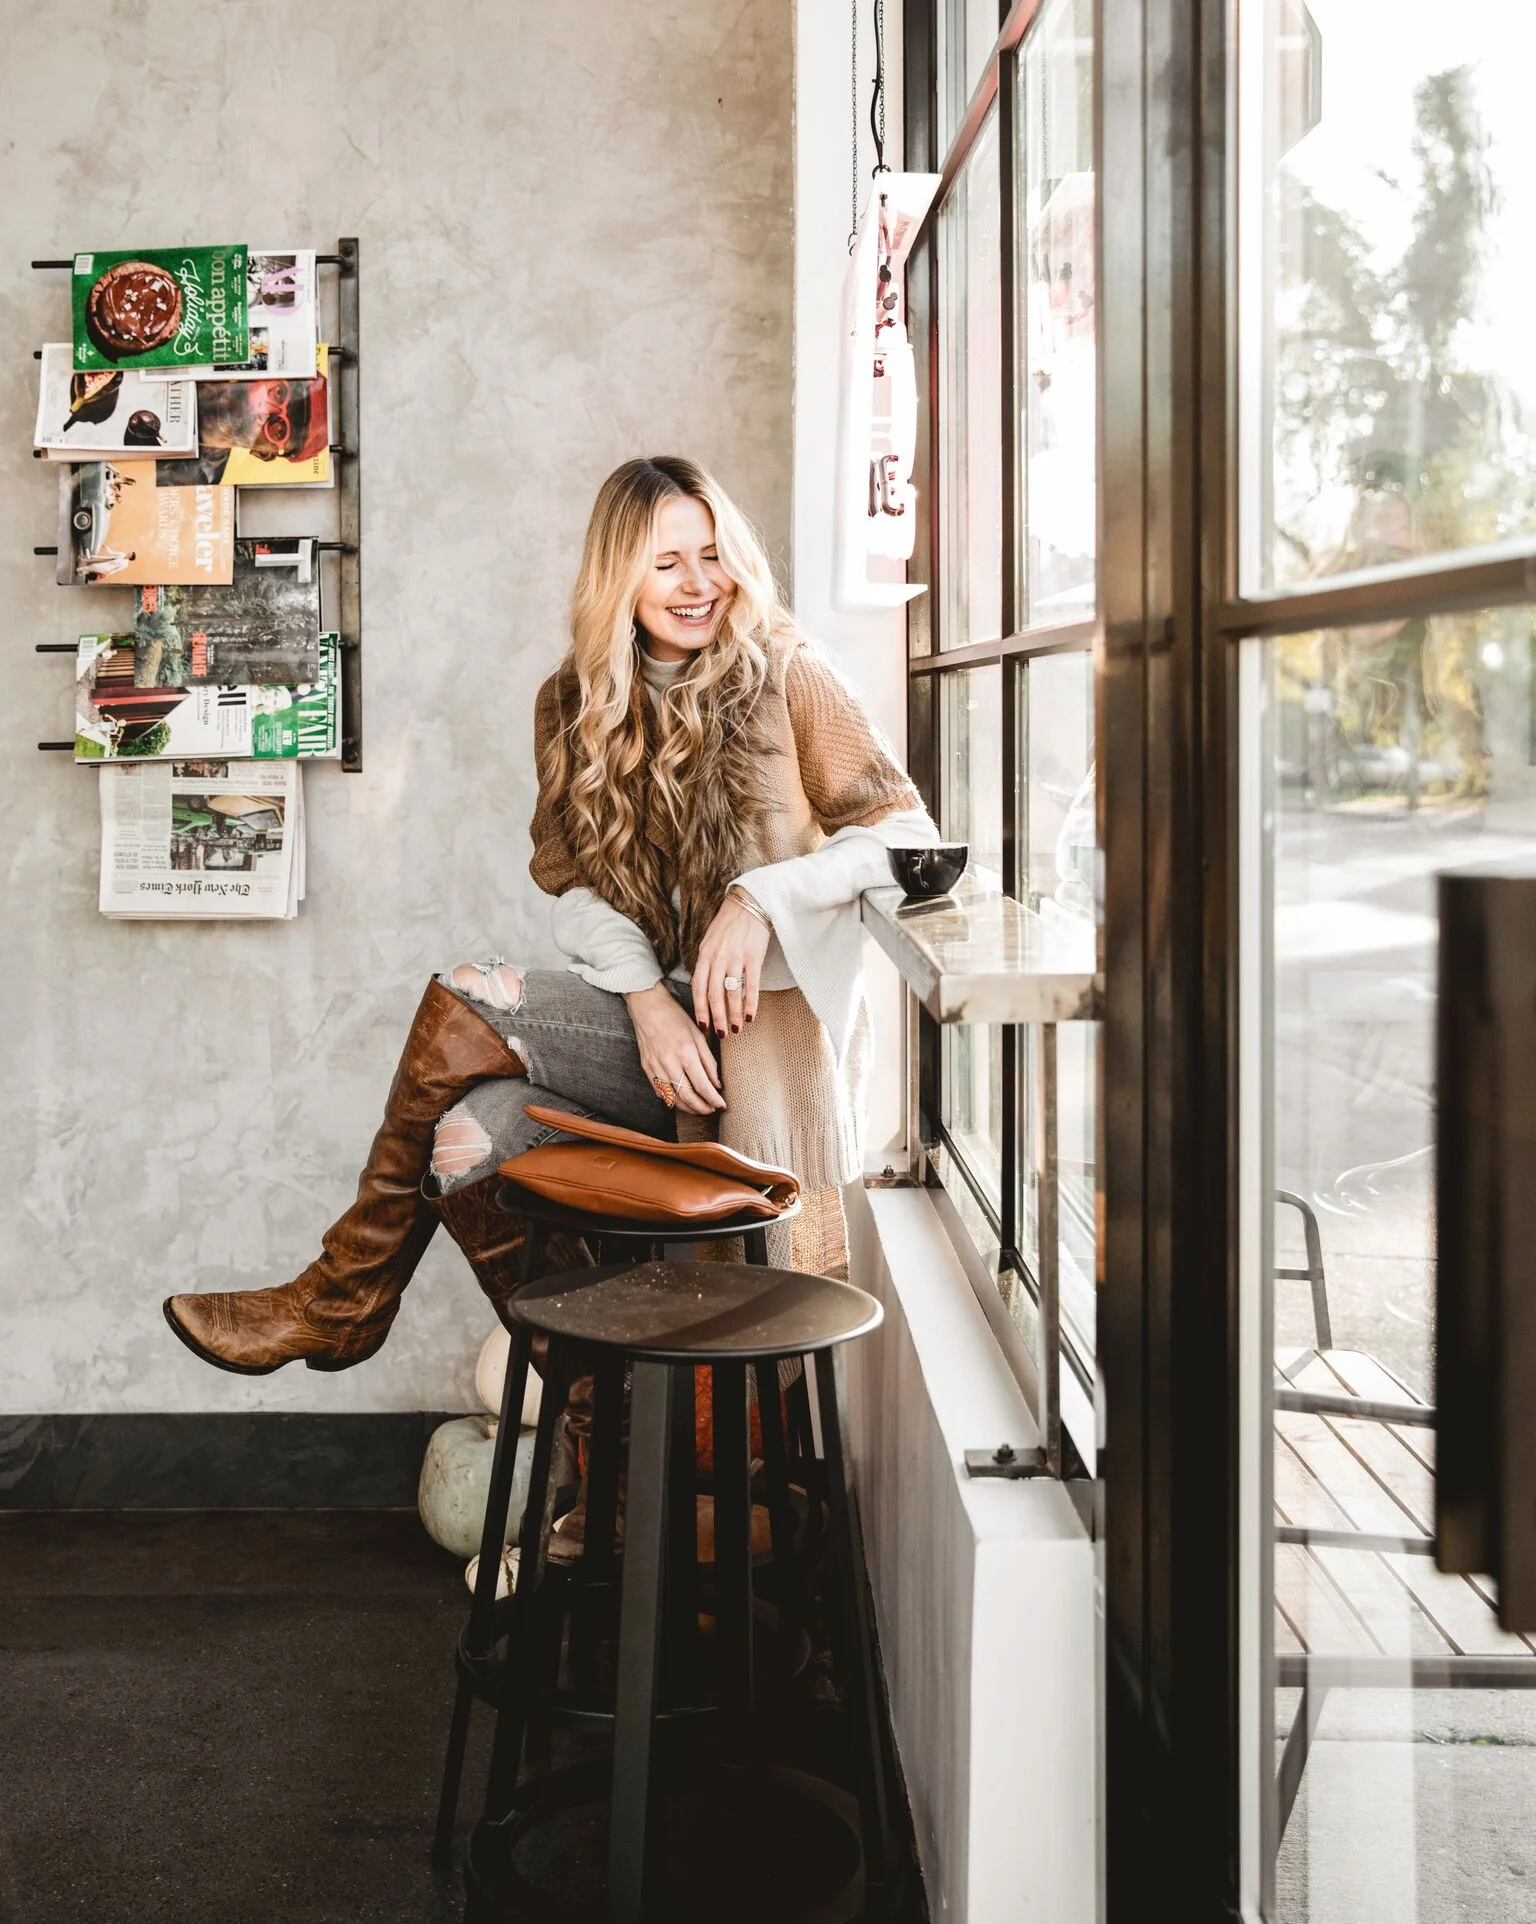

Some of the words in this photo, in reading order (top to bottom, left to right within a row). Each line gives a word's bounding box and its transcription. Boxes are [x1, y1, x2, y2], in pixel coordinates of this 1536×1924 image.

[210, 249, 231, 285] bon
[174, 258, 204, 356] Holiday
[205, 287, 232, 361] appétit
[168, 519, 180, 570] CHOICE
[255, 539, 313, 583] T
[202, 698, 210, 725] Design
[298, 709, 328, 757] FAIR
[139, 882, 174, 896] Times
[174, 880, 203, 896] York
[204, 883, 229, 896] New
[229, 883, 251, 897] The
